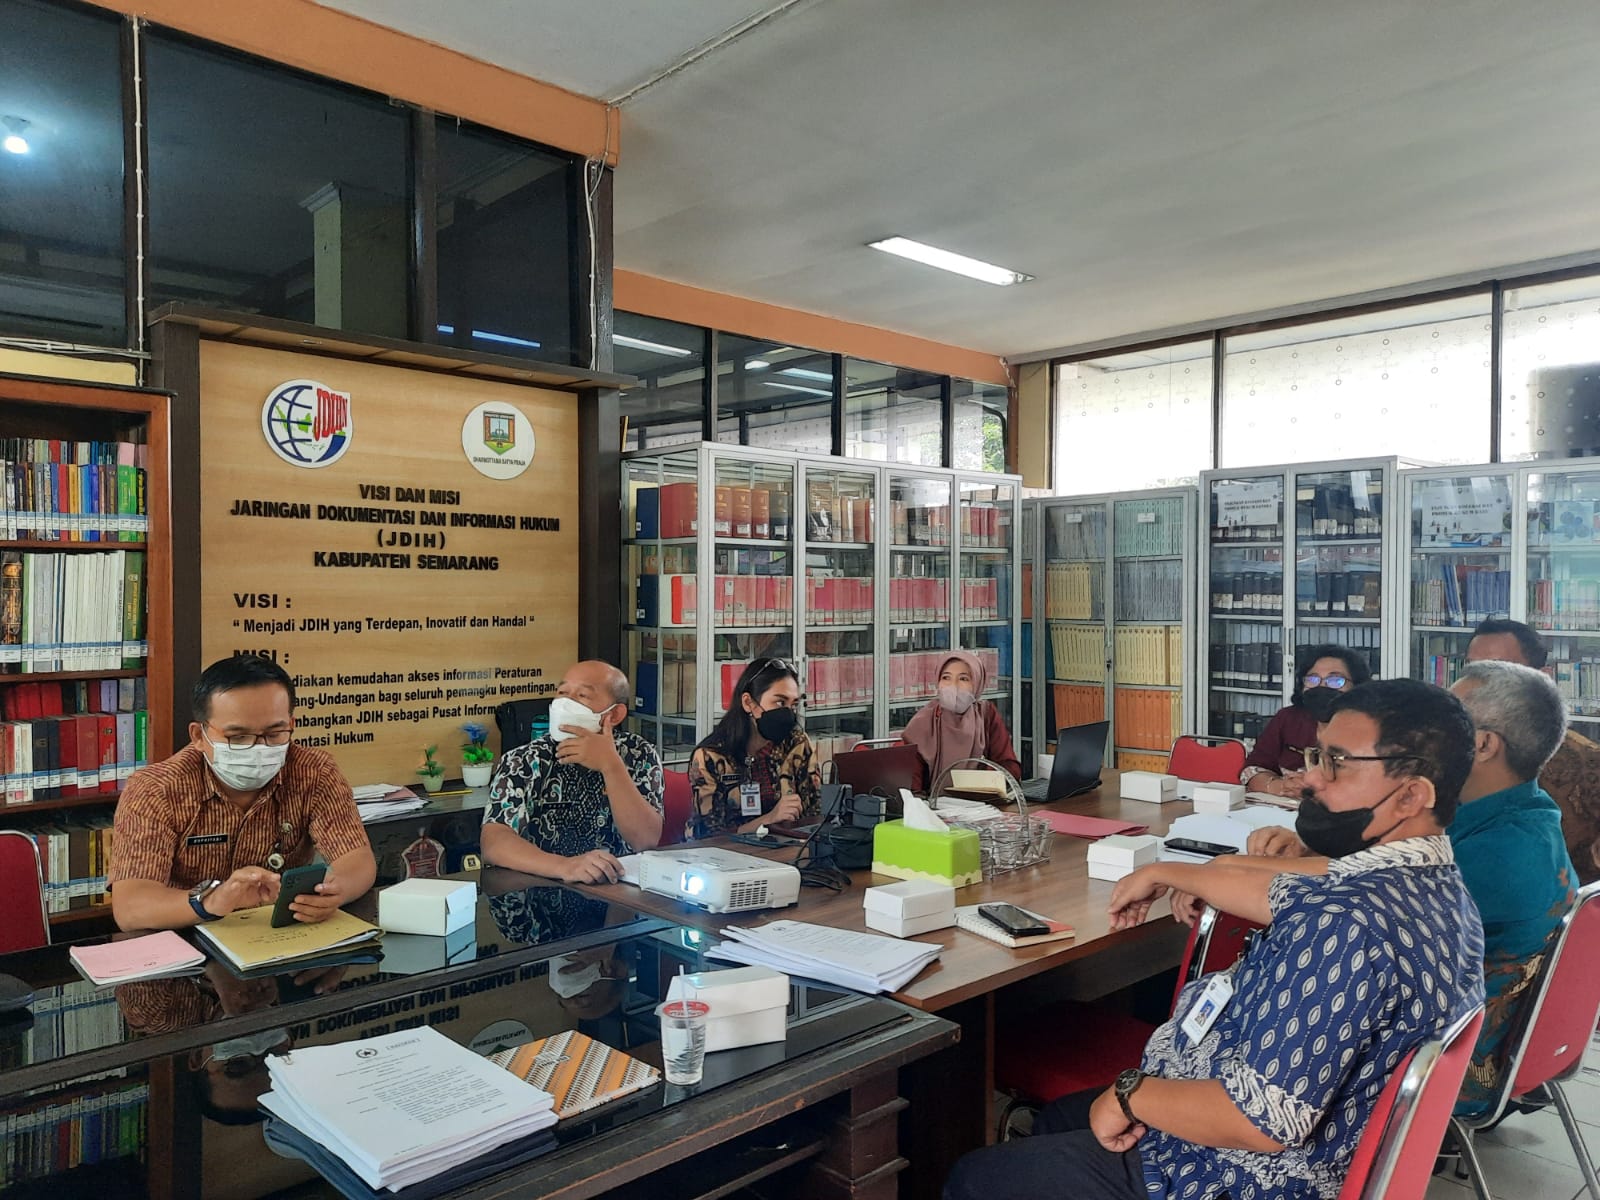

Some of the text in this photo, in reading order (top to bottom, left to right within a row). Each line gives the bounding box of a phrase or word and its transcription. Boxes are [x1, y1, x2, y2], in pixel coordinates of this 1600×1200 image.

[313, 388, 348, 442] JDIHN
[359, 484, 461, 506] VISI DAN MISI
[230, 499, 560, 532] JARINGAN DOKUMENTASI DAN INFORMASI HUKUM
[314, 551, 499, 571] KABUPATEN SEMARANG
[233, 593, 278, 609] VISI
[243, 618, 296, 636] Menjadi
[299, 618, 330, 632] JDIH
[333, 620, 363, 634] yang
[365, 616, 423, 633] Terdepan,
[426, 615, 467, 629] Inovatif
[469, 615, 489, 628] dan
[492, 615, 527, 627] Handal
[337, 671, 404, 686] kemudahan
[407, 669, 440, 682] akses
[443, 667, 492, 681] informasi
[494, 667, 542, 679] Peraturan
[379, 689, 402, 705] bagi
[404, 686, 443, 702] seluruh
[446, 685, 497, 701] pemangku
[355, 710, 384, 724] JDIH
[387, 707, 429, 723] sebagai
[432, 706, 461, 719] Pusat
[334, 731, 374, 745] Hukum
